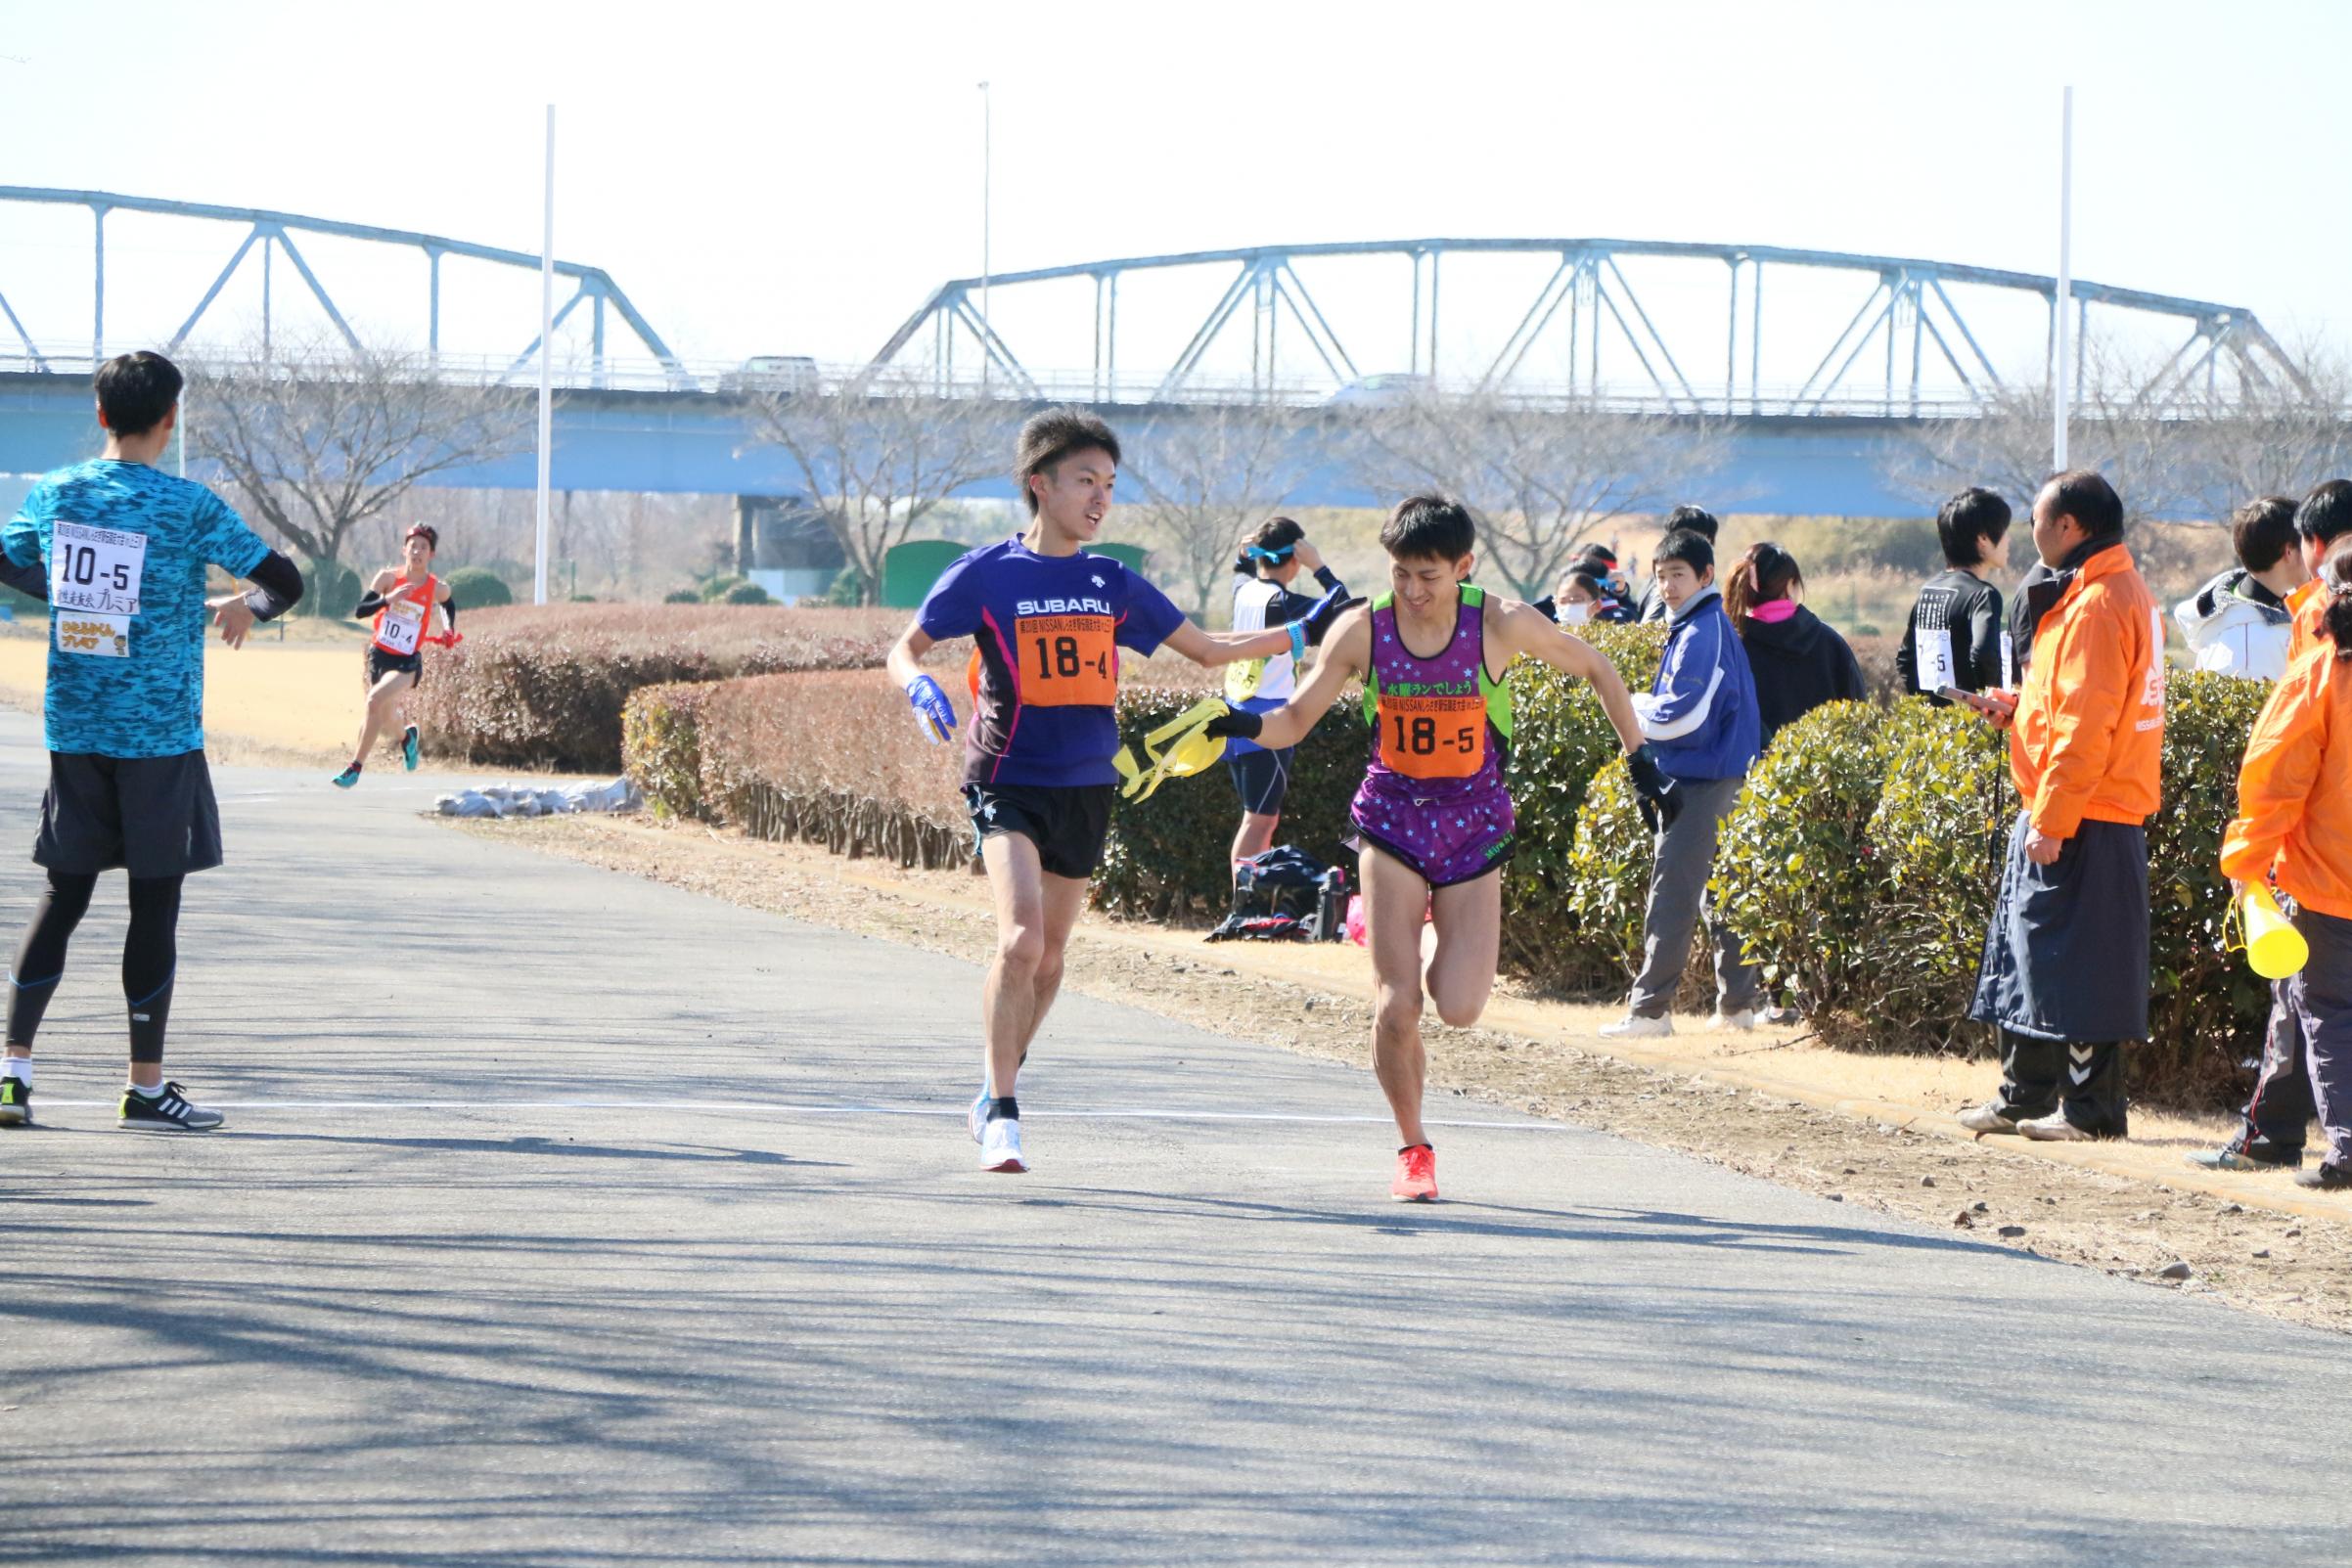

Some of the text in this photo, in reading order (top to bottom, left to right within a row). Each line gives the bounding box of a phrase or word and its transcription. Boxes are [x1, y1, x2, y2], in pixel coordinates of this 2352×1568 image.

[62, 544, 130, 591] 10-5
[1017, 598, 1111, 615] SUBARU
[384, 620, 413, 644] 10-4
[1035, 636, 1108, 680] 18-4
[1393, 715, 1474, 755] 18-5
